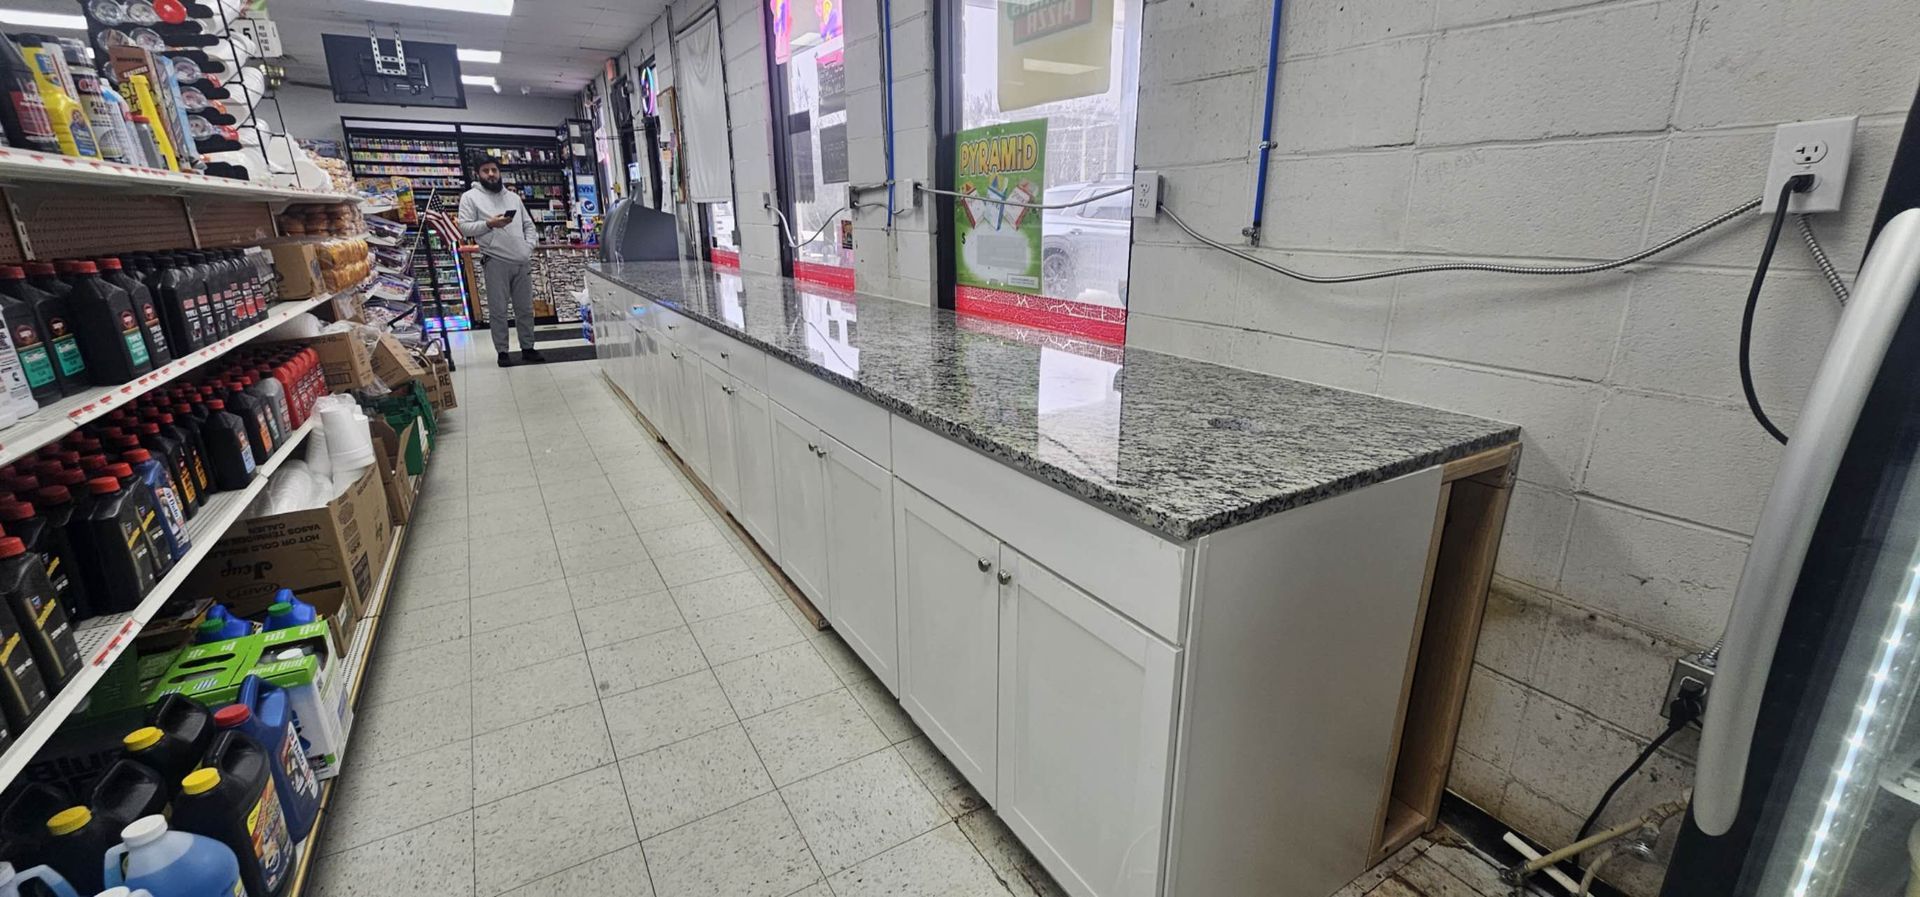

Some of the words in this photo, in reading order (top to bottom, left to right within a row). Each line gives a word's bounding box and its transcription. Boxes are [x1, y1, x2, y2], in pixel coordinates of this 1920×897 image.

[287, 524, 321, 534] VASOS
[281, 537, 297, 546] OR
[299, 534, 320, 543] HOT
